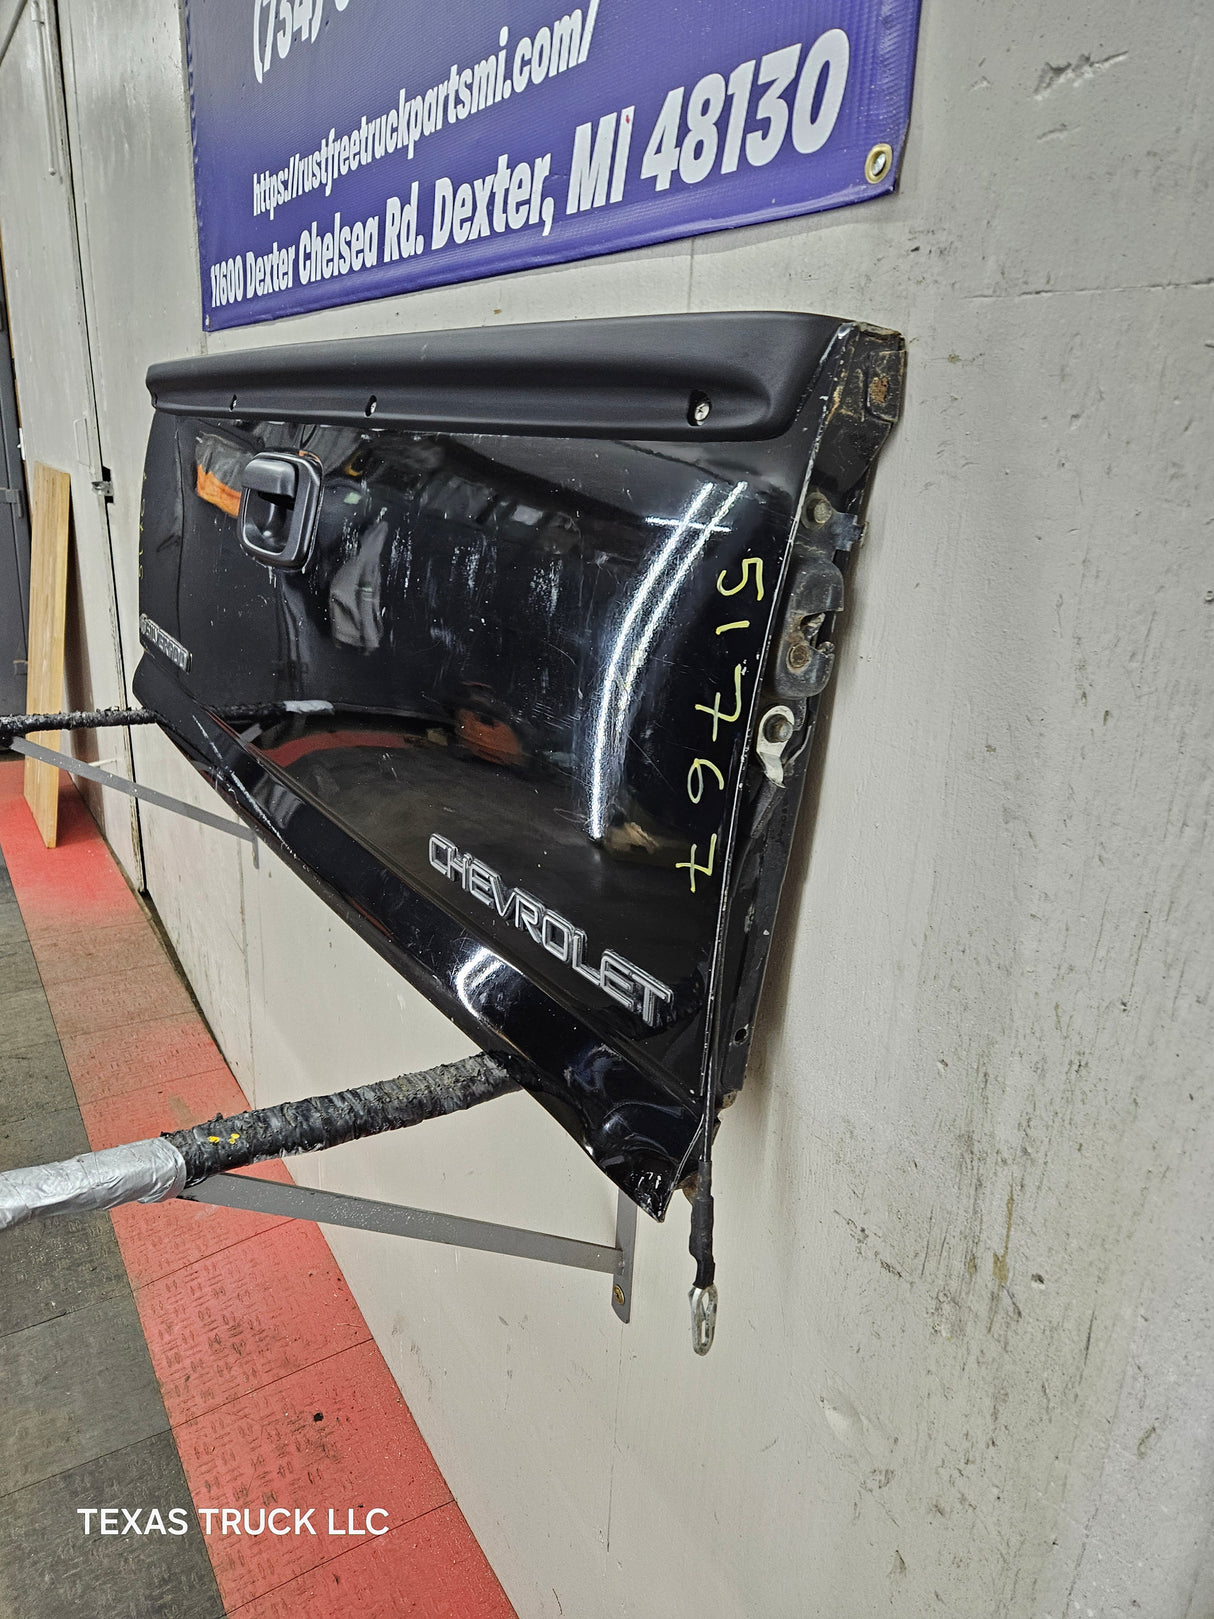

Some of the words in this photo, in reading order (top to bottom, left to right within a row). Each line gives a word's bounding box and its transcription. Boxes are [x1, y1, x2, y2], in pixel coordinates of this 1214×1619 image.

[210, 254, 244, 308] 11600
[245, 242, 296, 299] Dexter
[298, 212, 379, 285] Chelsea
[384, 182, 424, 263] Rd.
[431, 153, 555, 236] Dexter,
[566, 105, 635, 215] MI
[640, 28, 850, 191] 48130
[253, 0, 600, 220] https://rustfreetruckpartsmi.com/
[428, 833, 674, 1027] CHEVROLET
